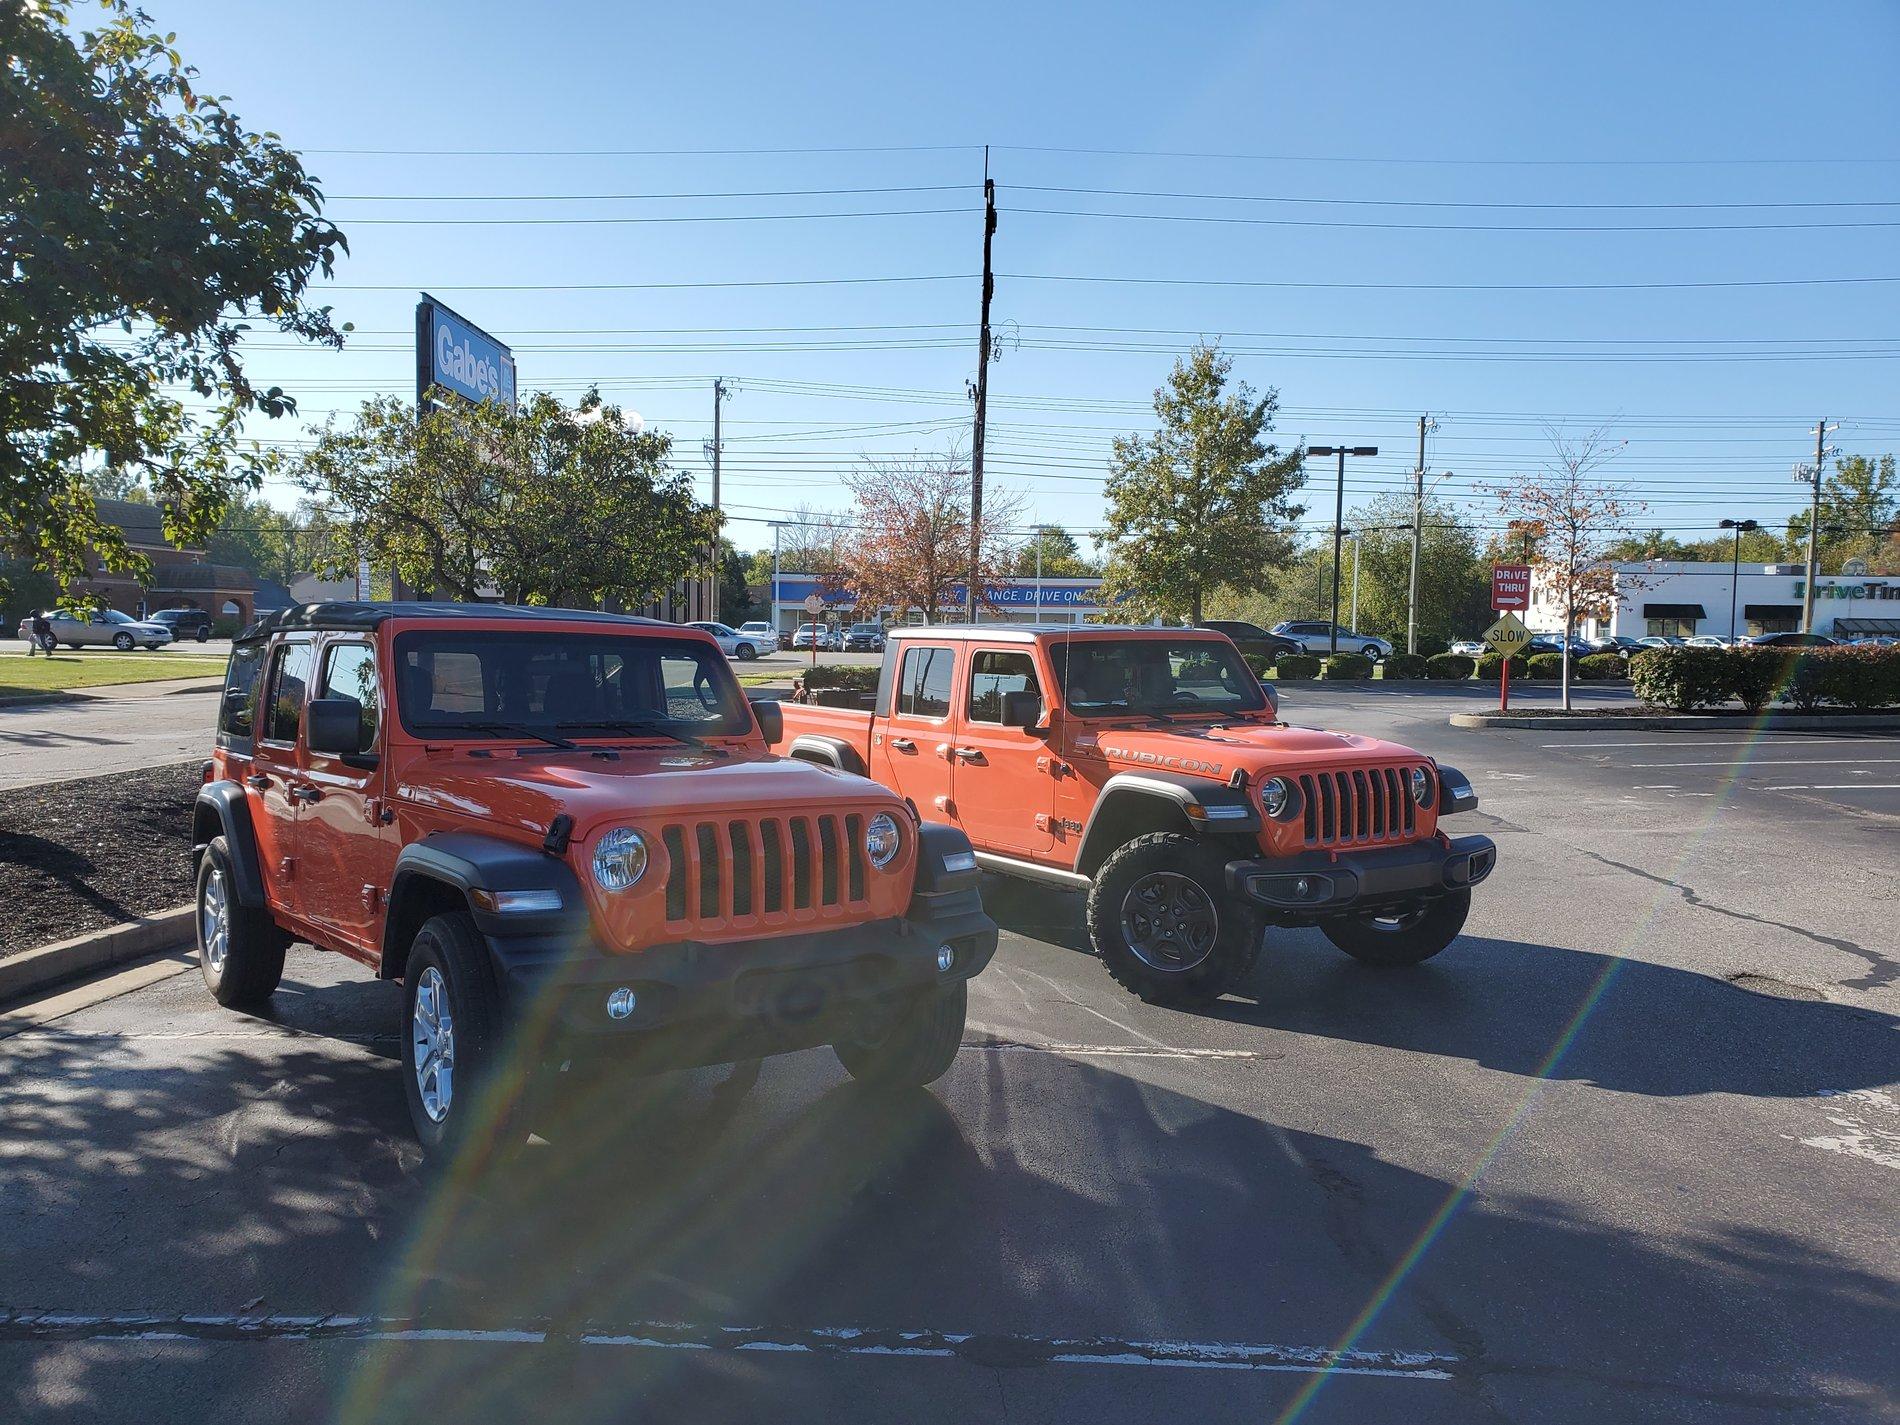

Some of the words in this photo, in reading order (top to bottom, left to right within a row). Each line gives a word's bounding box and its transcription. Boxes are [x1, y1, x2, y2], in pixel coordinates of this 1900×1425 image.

[438, 324, 499, 400] Gabe's
[1496, 570, 1528, 580] DRIVE
[1498, 583, 1526, 593] THRU
[1492, 629, 1525, 642] SLOW
[1104, 747, 1222, 774] RUBICON
